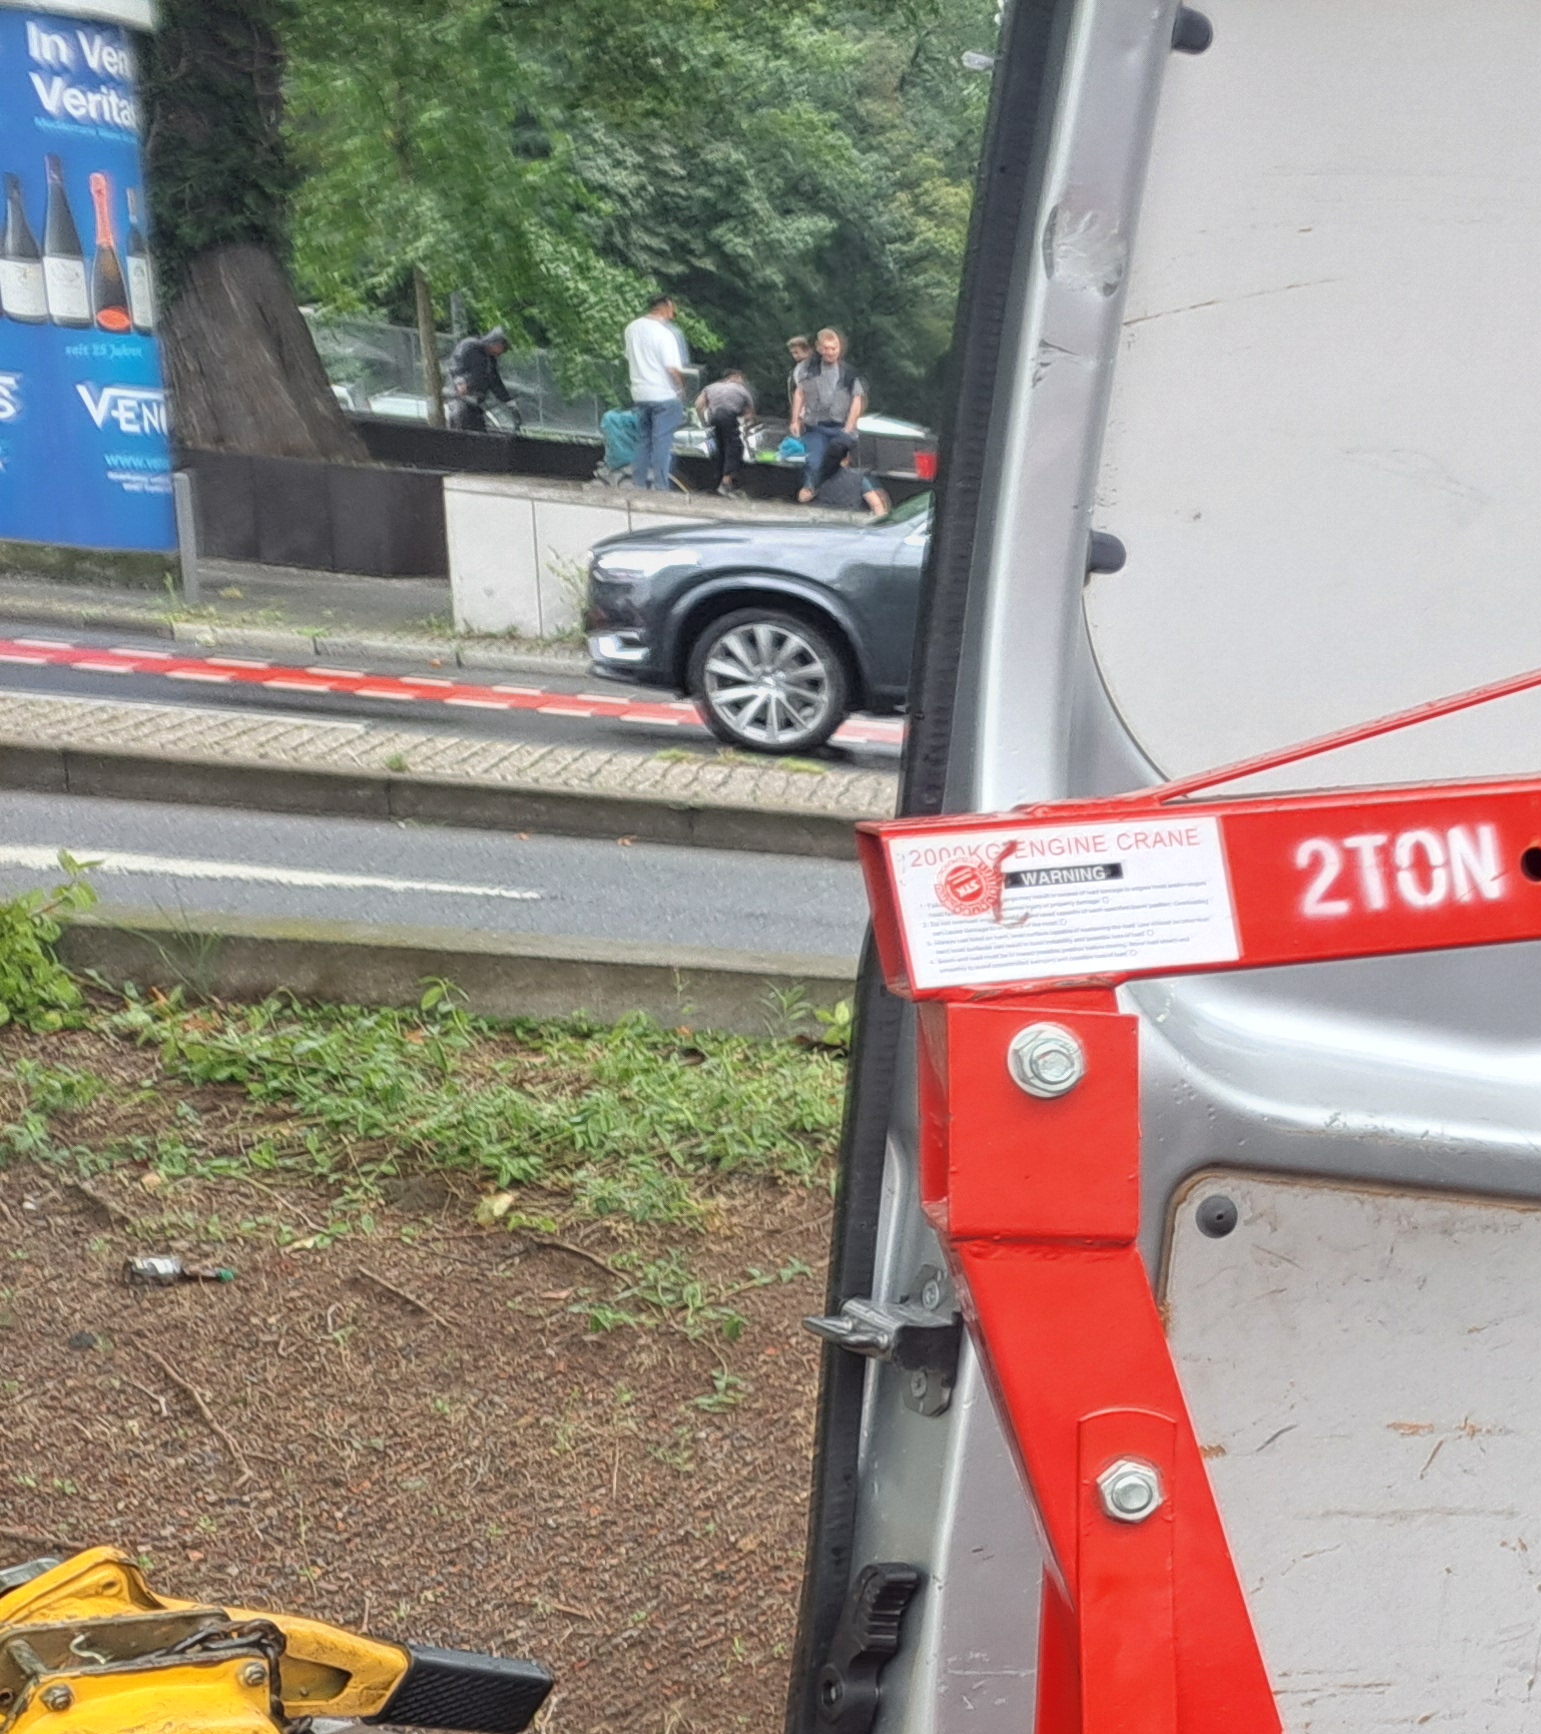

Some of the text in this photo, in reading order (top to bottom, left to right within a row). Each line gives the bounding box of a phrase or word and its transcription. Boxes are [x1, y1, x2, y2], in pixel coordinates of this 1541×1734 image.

[26, 20, 69, 64] In
[1016, 834, 1106, 859] ENGINE
[1116, 827, 1201, 851] CRANE
[1021, 865, 1106, 886] WARNING
[1297, 824, 1504, 918] 2TON
